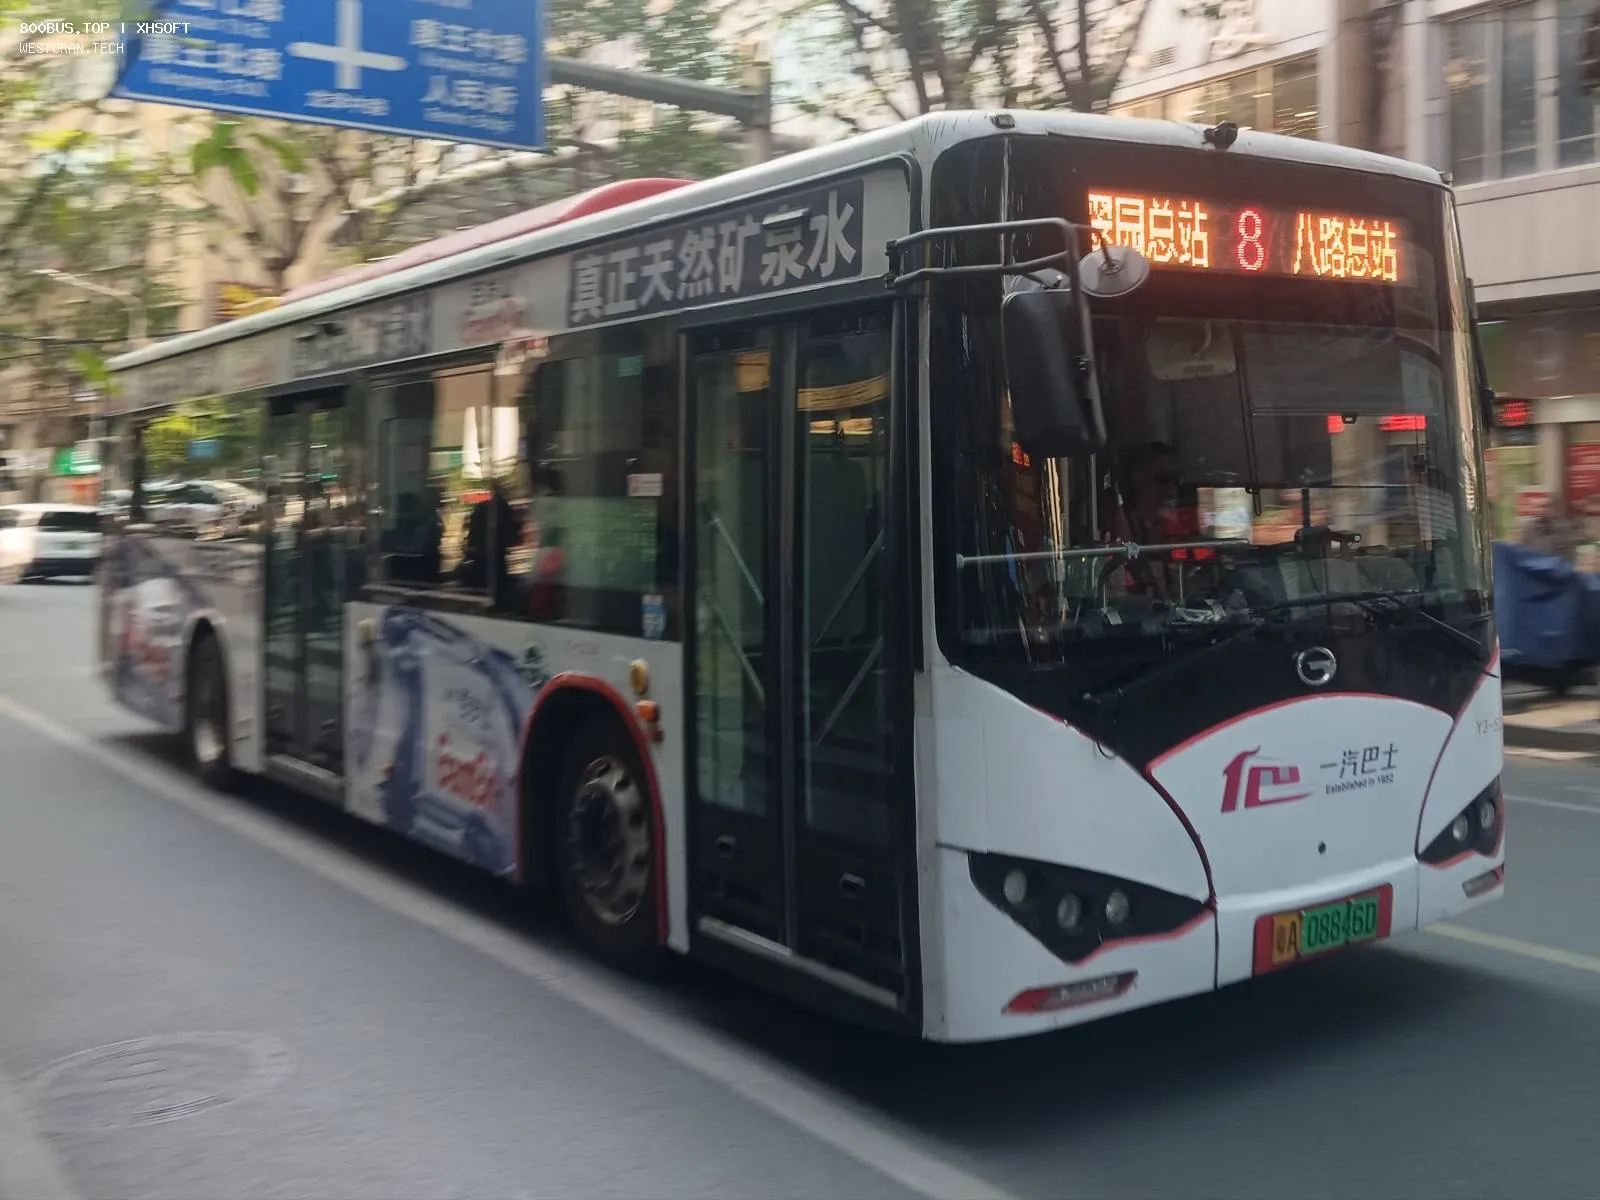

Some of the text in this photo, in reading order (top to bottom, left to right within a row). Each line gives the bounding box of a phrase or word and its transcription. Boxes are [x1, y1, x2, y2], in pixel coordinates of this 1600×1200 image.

[570, 190, 857, 324] 真正天然矿泉水
[1237, 209, 1265, 272] 8
[1293, 212, 1398, 282] 八路总站
[1319, 742, 1399, 779] 一汽巴士
